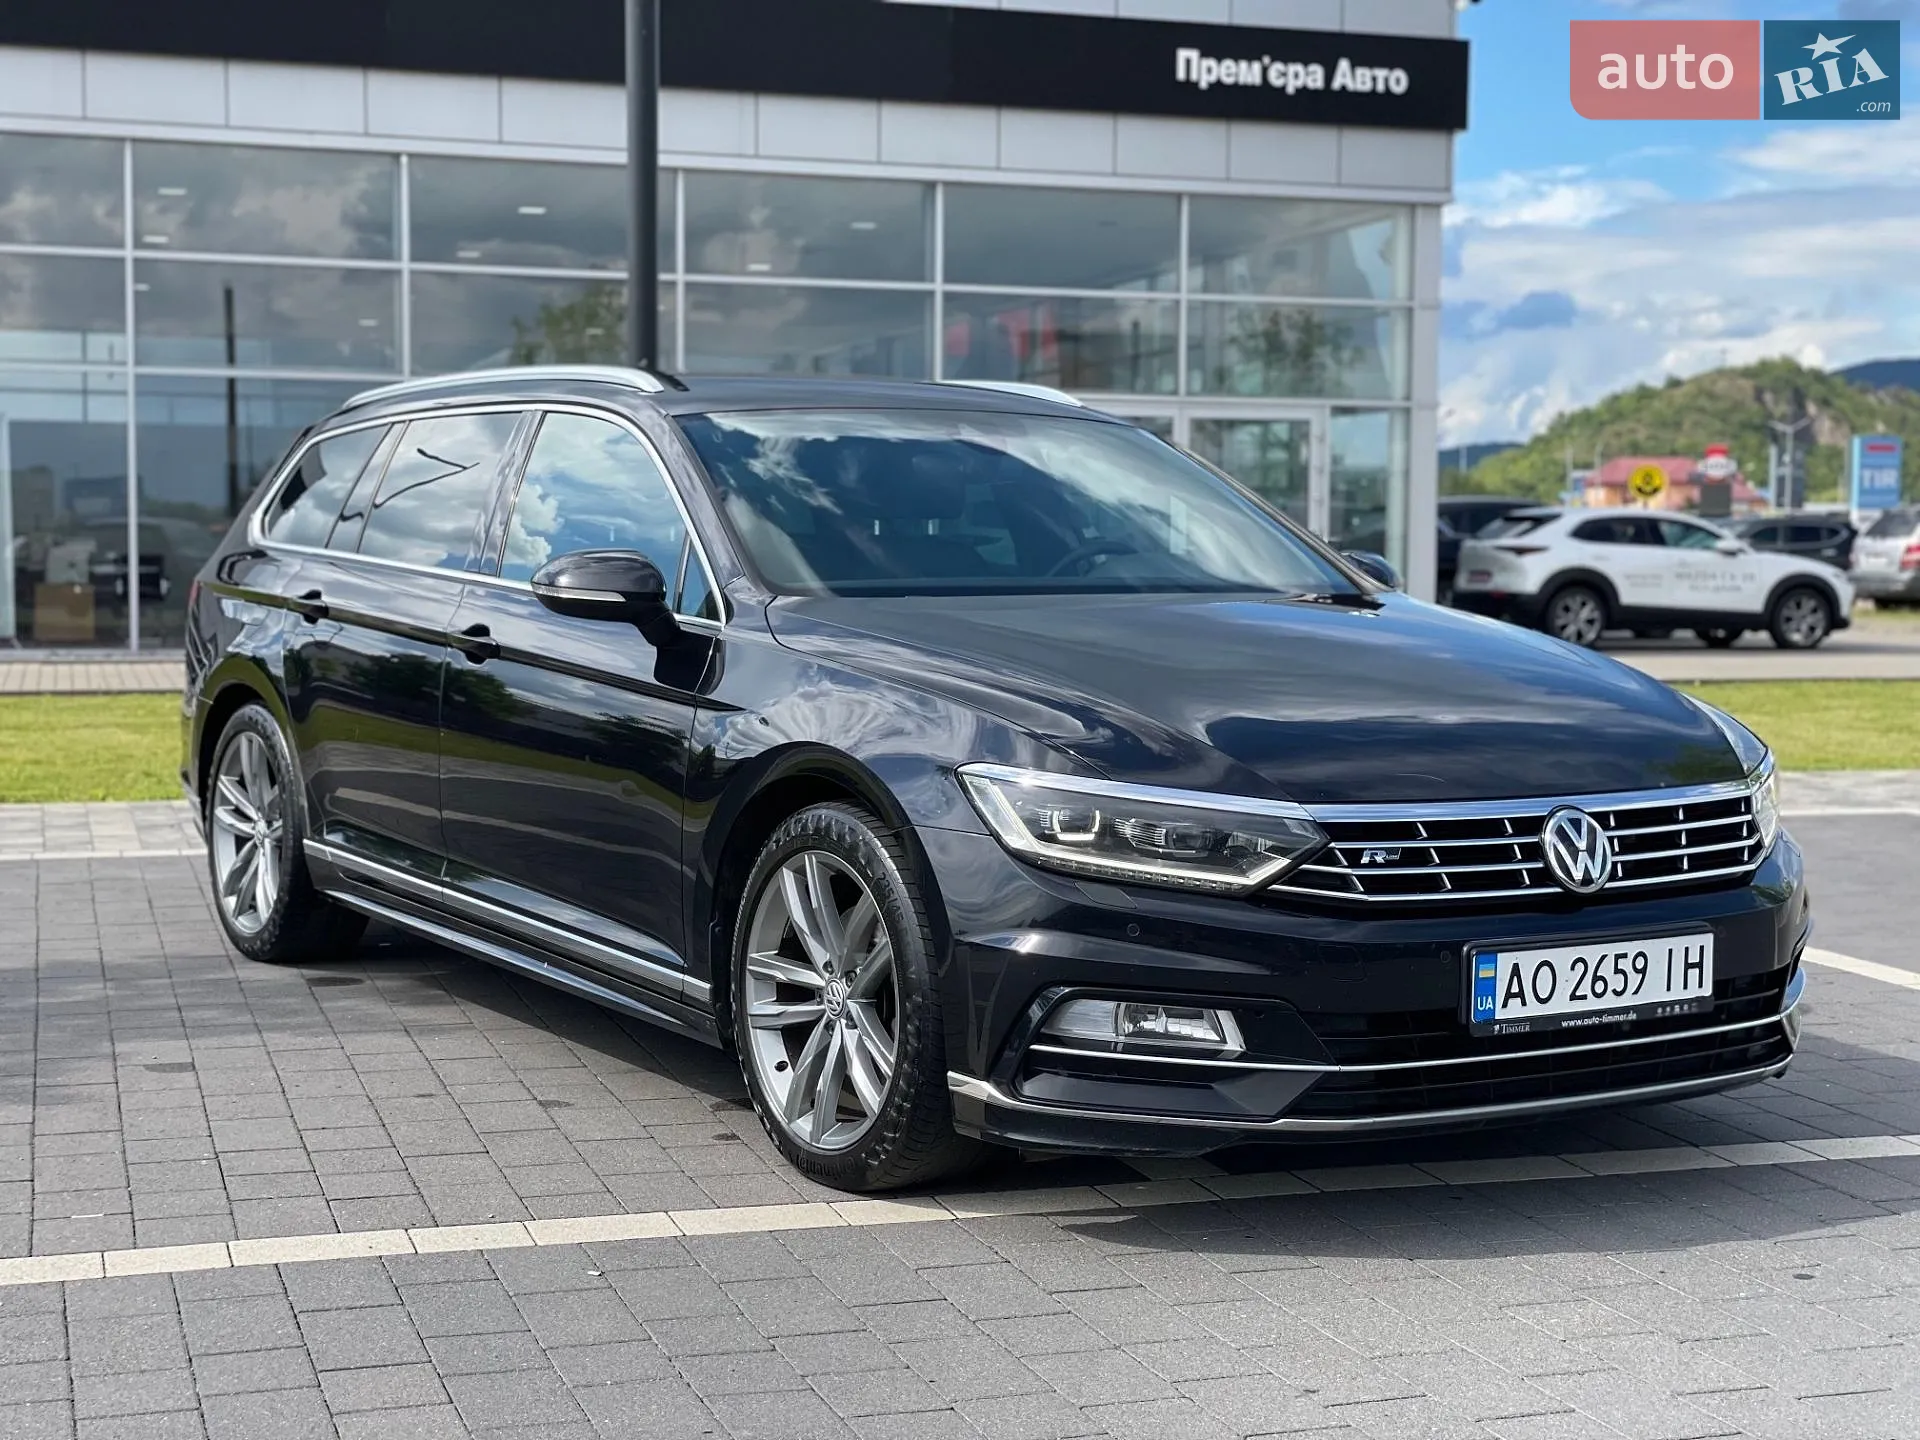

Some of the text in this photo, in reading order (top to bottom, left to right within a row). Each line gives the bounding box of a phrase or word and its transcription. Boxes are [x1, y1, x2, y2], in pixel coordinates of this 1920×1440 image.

[1175, 47, 1410, 96] Прем'єра Авто
[1501, 944, 1706, 1009] AO 2659 IH
[1477, 996, 1494, 1011] UA
[1561, 1010, 1637, 1028] www.auto-timmer.de
